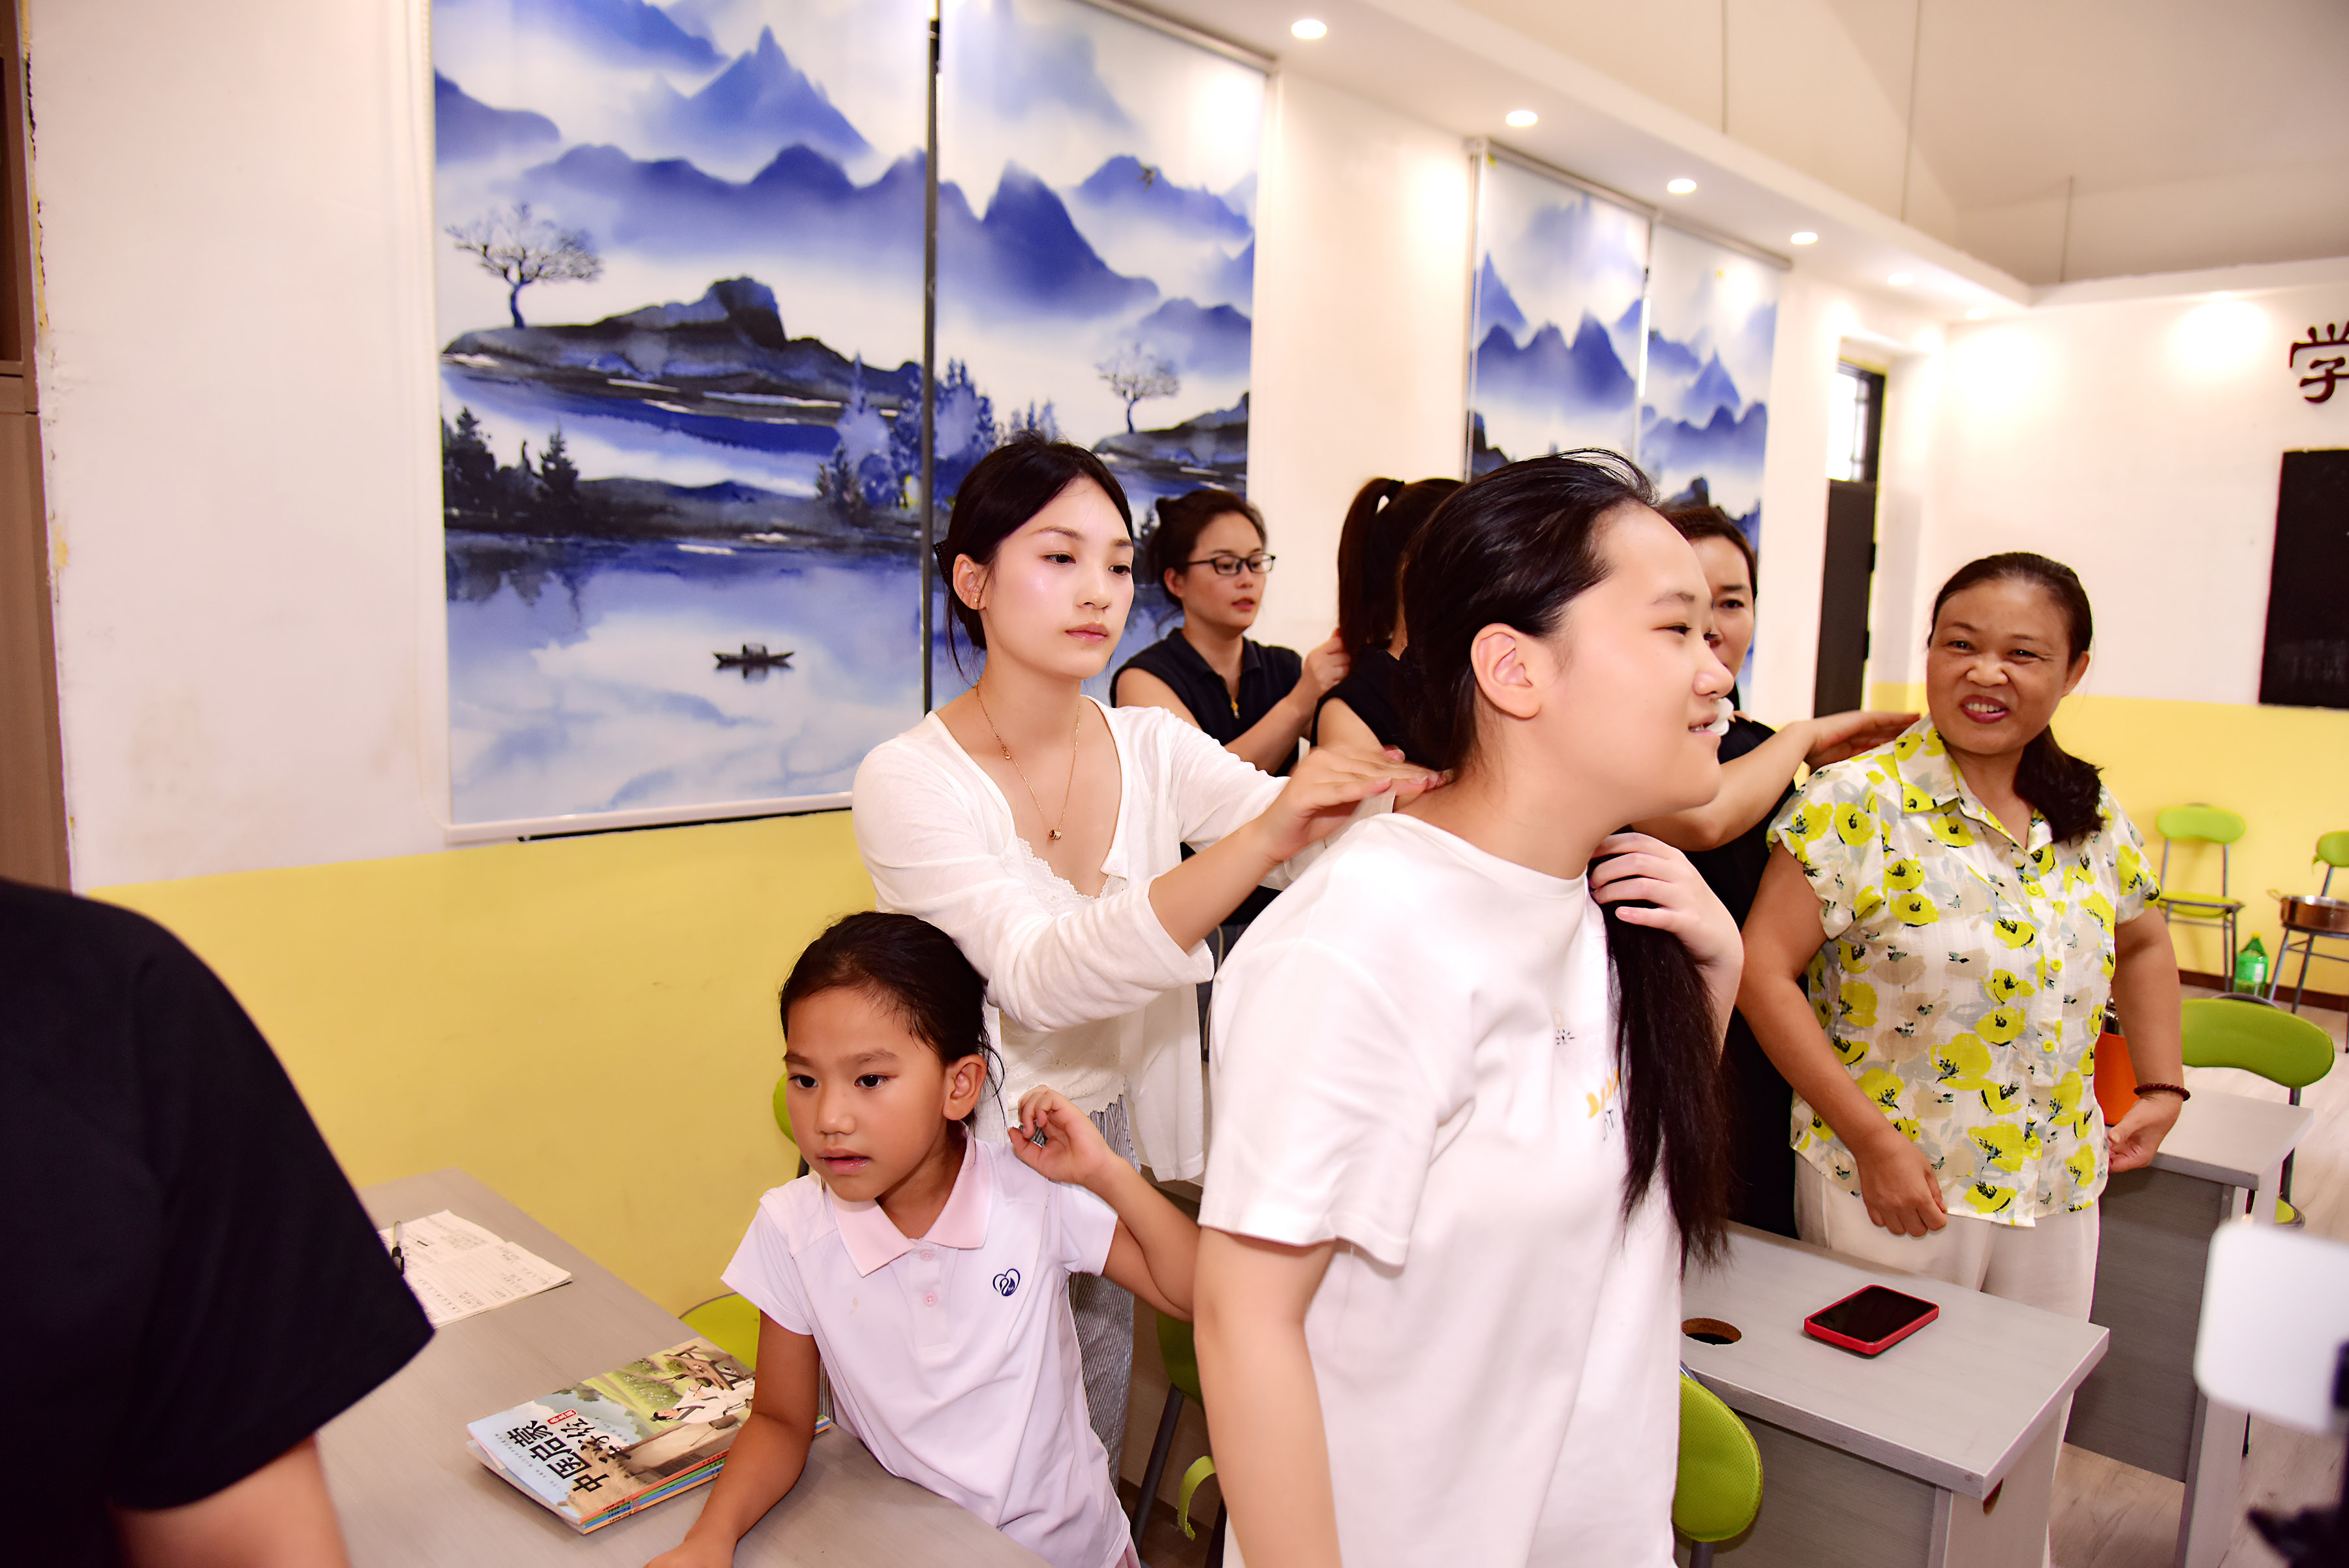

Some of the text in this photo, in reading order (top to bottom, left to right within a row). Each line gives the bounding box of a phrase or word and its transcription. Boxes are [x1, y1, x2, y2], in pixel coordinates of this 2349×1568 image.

[2289, 320, 2349, 403] 学
[507, 1421, 609, 1492] 中医启蒙
[560, 1418, 631, 1463] 三字经
